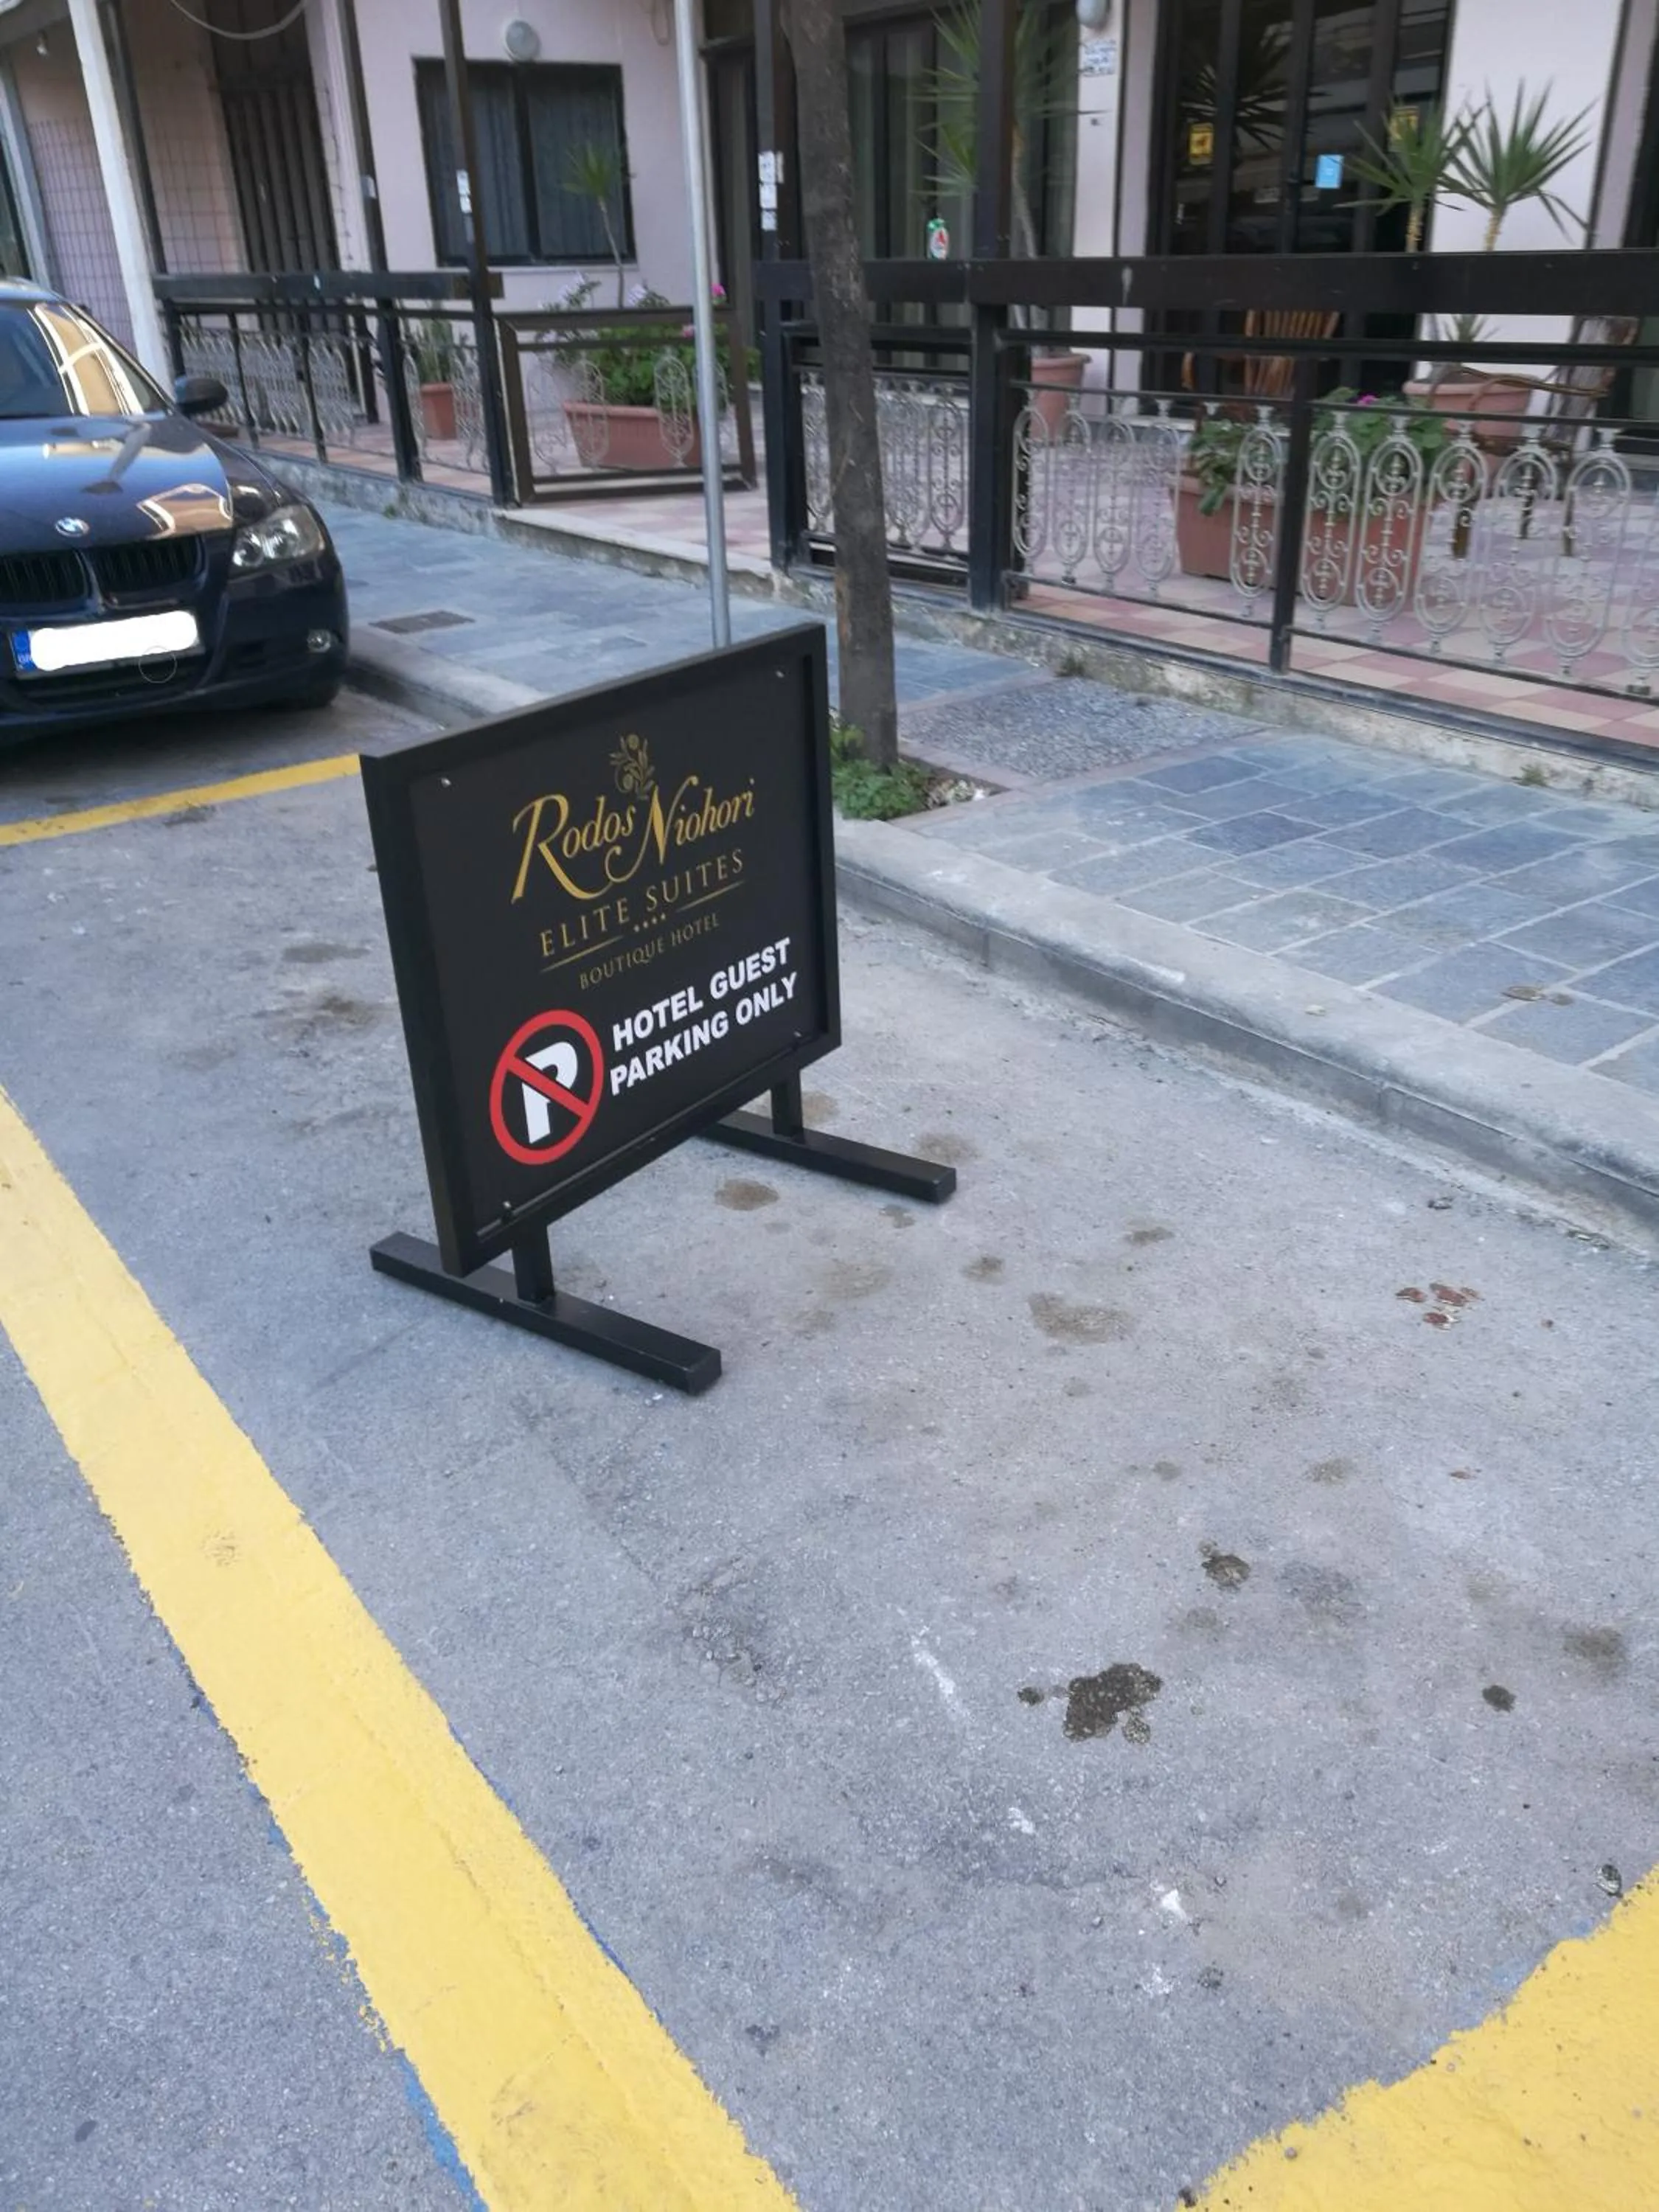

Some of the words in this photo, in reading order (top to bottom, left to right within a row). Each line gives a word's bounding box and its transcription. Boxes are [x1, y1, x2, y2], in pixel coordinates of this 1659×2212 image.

[512, 794, 634, 904] Rodos
[605, 776, 755, 882] Niohori
[540, 897, 630, 956] ELITE
[645, 849, 744, 911] SUITES
[580, 938, 665, 990] BOUTIQUE
[671, 912, 720, 947] HOTEL
[610, 1011, 730, 1096] PARKING
[735, 972, 798, 1026] ONLY
[612, 986, 703, 1053] HOTEL
[709, 937, 791, 1000] GUEST
[521, 1042, 578, 1144] P
